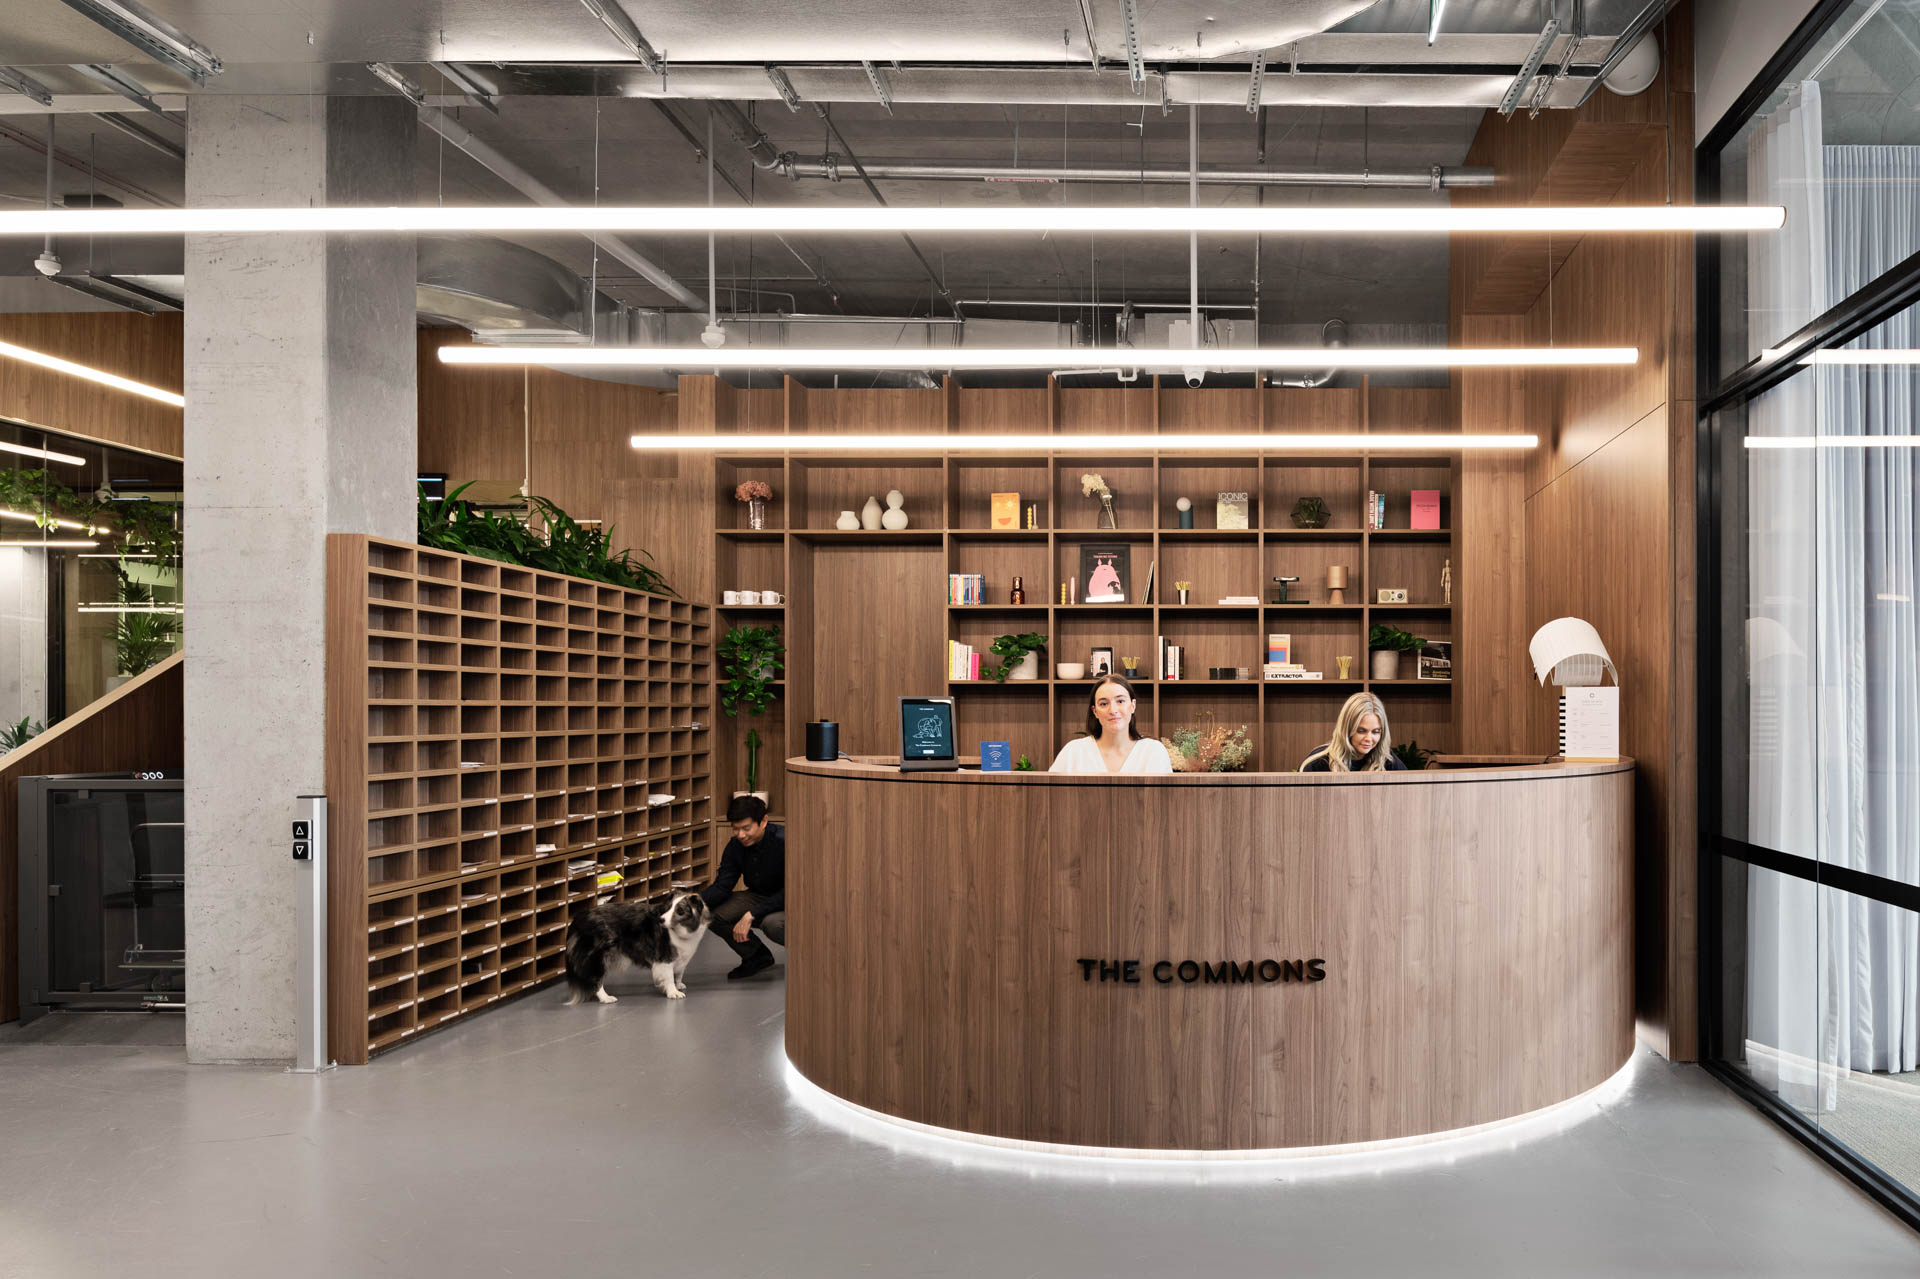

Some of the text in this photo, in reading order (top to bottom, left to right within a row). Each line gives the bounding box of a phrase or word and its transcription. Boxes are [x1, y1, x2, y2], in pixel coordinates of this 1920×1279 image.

[1218, 492, 1248, 501] ICONIC
[1076, 959, 1326, 983] THE COMMONS
